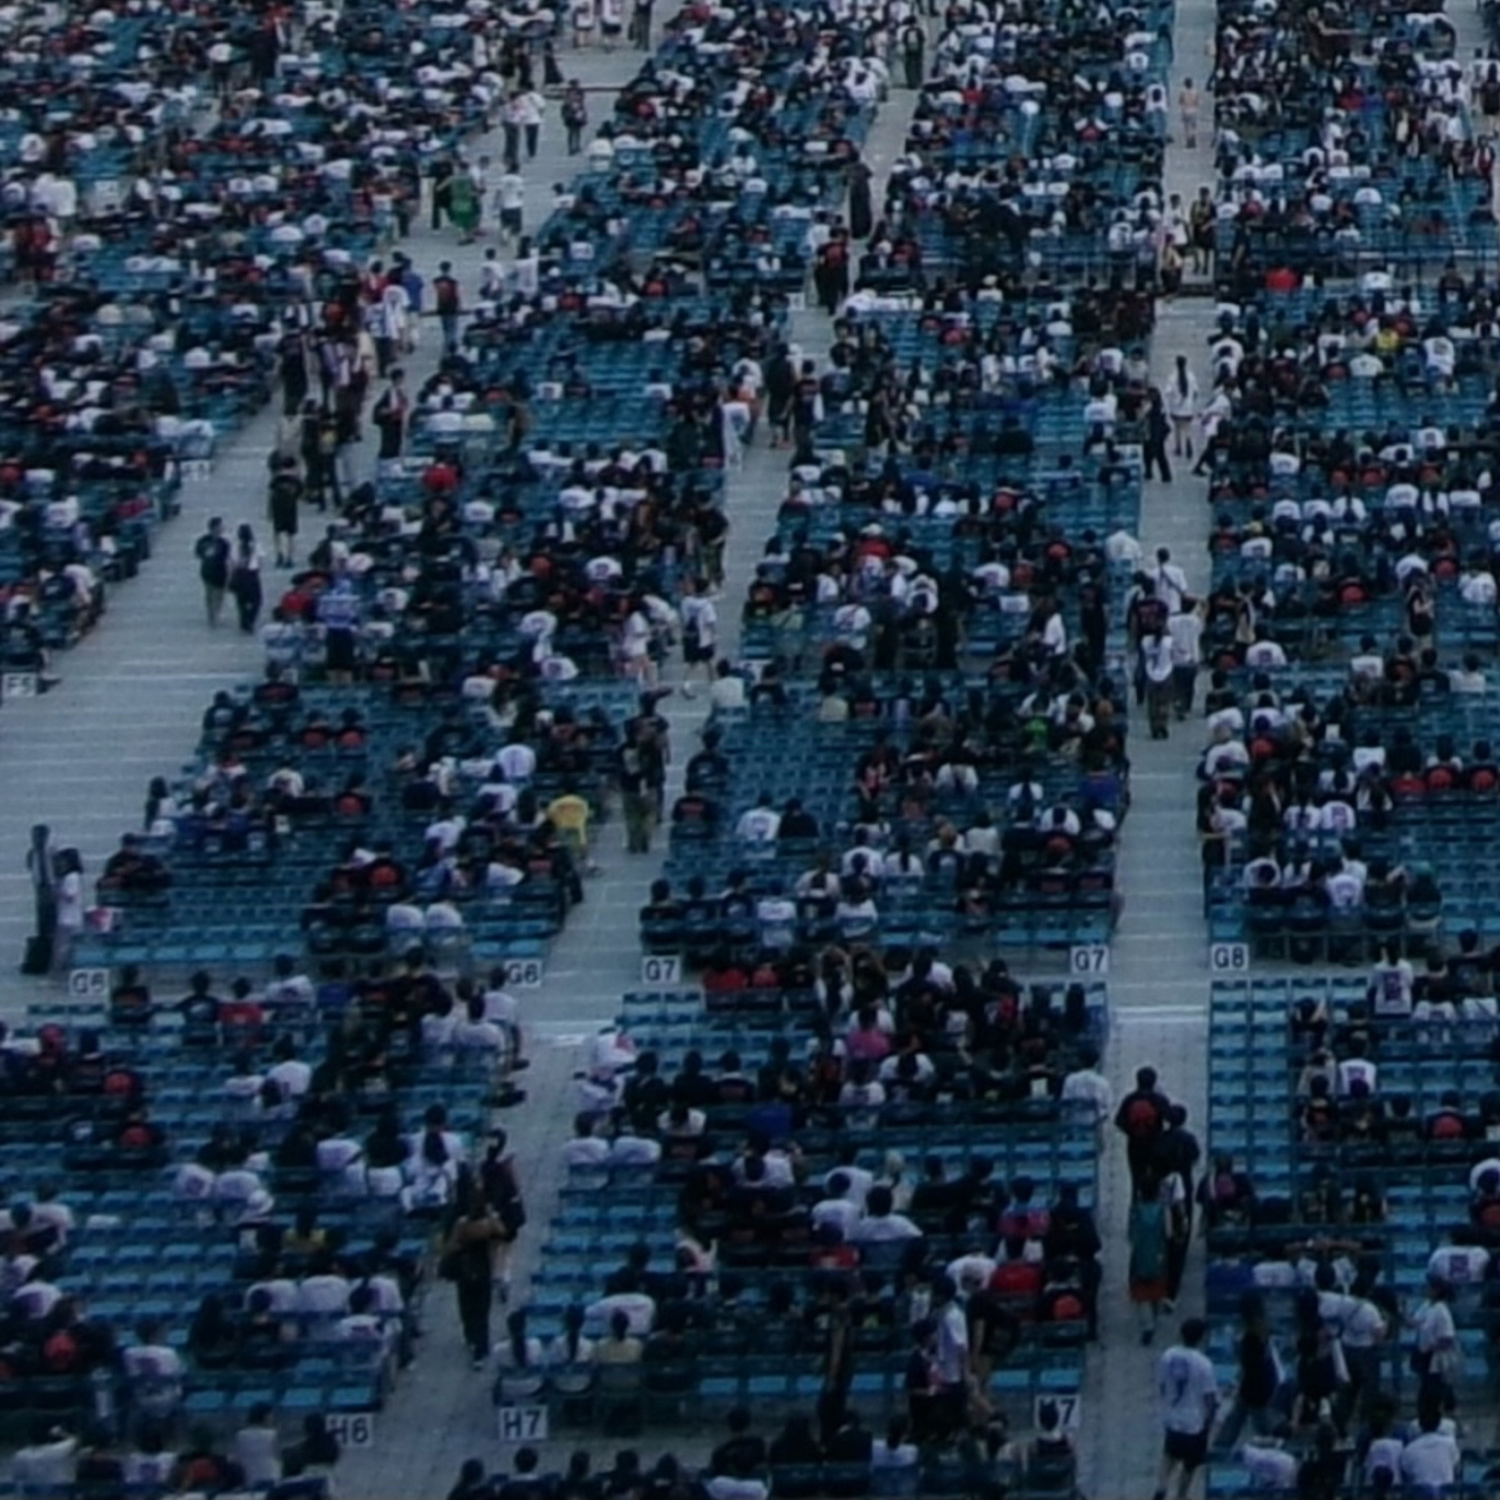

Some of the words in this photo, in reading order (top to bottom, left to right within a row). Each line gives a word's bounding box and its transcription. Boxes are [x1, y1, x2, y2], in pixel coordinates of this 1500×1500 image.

[1074, 948, 1106, 971] G7
[1213, 947, 1245, 969] G8
[507, 962, 539, 985] G6
[646, 960, 676, 981] G7
[328, 1418, 368, 1444] H6
[505, 1409, 541, 1437] H7
